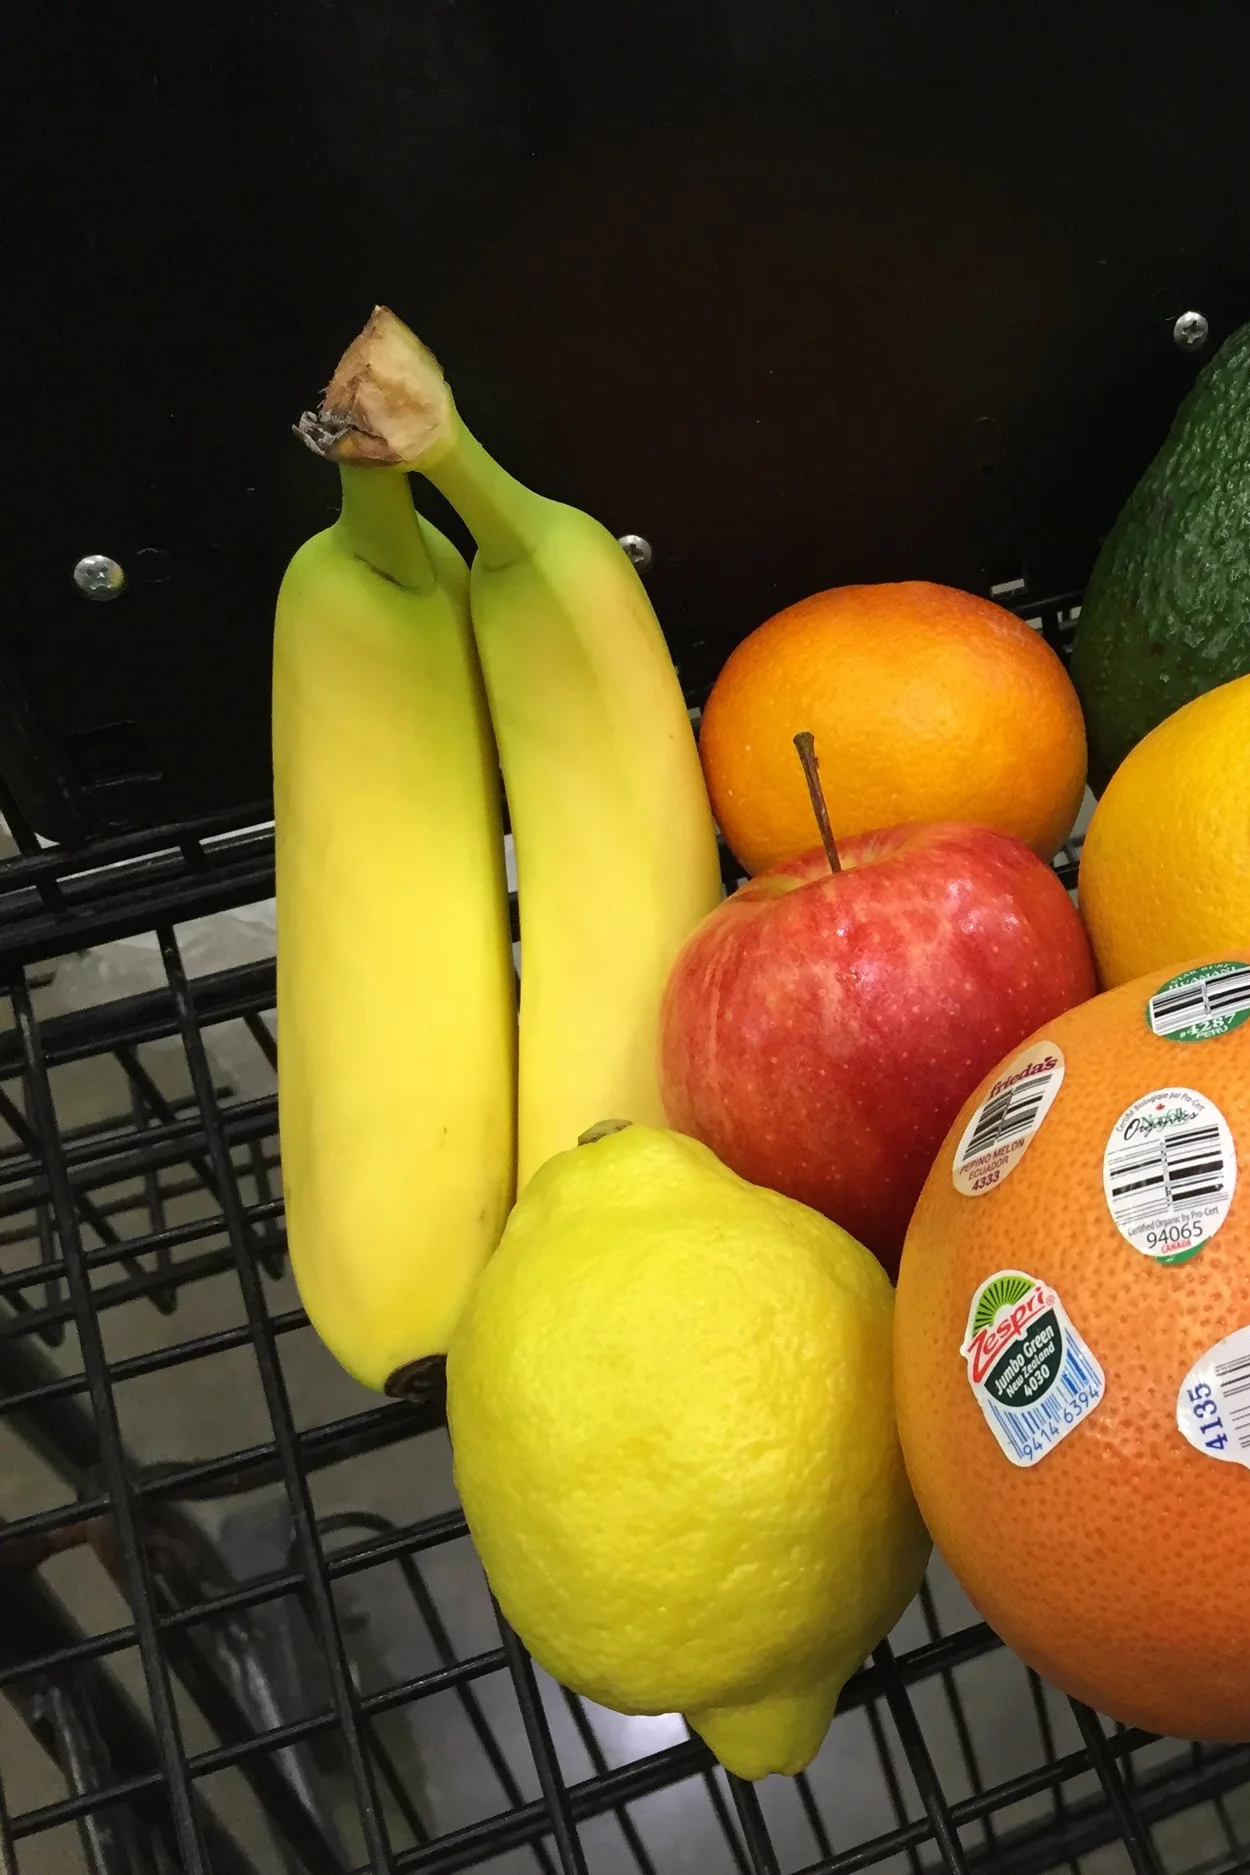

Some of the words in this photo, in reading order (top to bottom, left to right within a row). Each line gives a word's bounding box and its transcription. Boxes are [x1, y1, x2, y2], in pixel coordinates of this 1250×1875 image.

[1196, 1025, 1229, 1039] PERU
[990, 1056, 1059, 1100] frieda's
[959, 1153, 991, 1175] PEPINO
[992, 1137, 1025, 1158] MELON
[968, 1155, 1009, 1181] ECUADOR
[972, 1170, 1000, 1191] 4333
[1127, 1221, 1155, 1236] Certified
[1155, 1215, 1180, 1229] Organic
[1181, 1213, 1190, 1222] by
[1191, 1207, 1219, 1220] Pro-Cert
[1146, 1220, 1203, 1249] 94065
[1161, 1239, 1191, 1254] CANADA
[966, 1286, 1045, 1384] Zespri
[995, 1354, 1025, 1395] Jumbo
[1023, 1325, 1054, 1357] Green
[1006, 1374, 1024, 1398] New
[1022, 1340, 1055, 1379] Zealand
[1024, 1364, 1050, 1396] 4030
[1187, 1383, 1228, 1450] 4135
